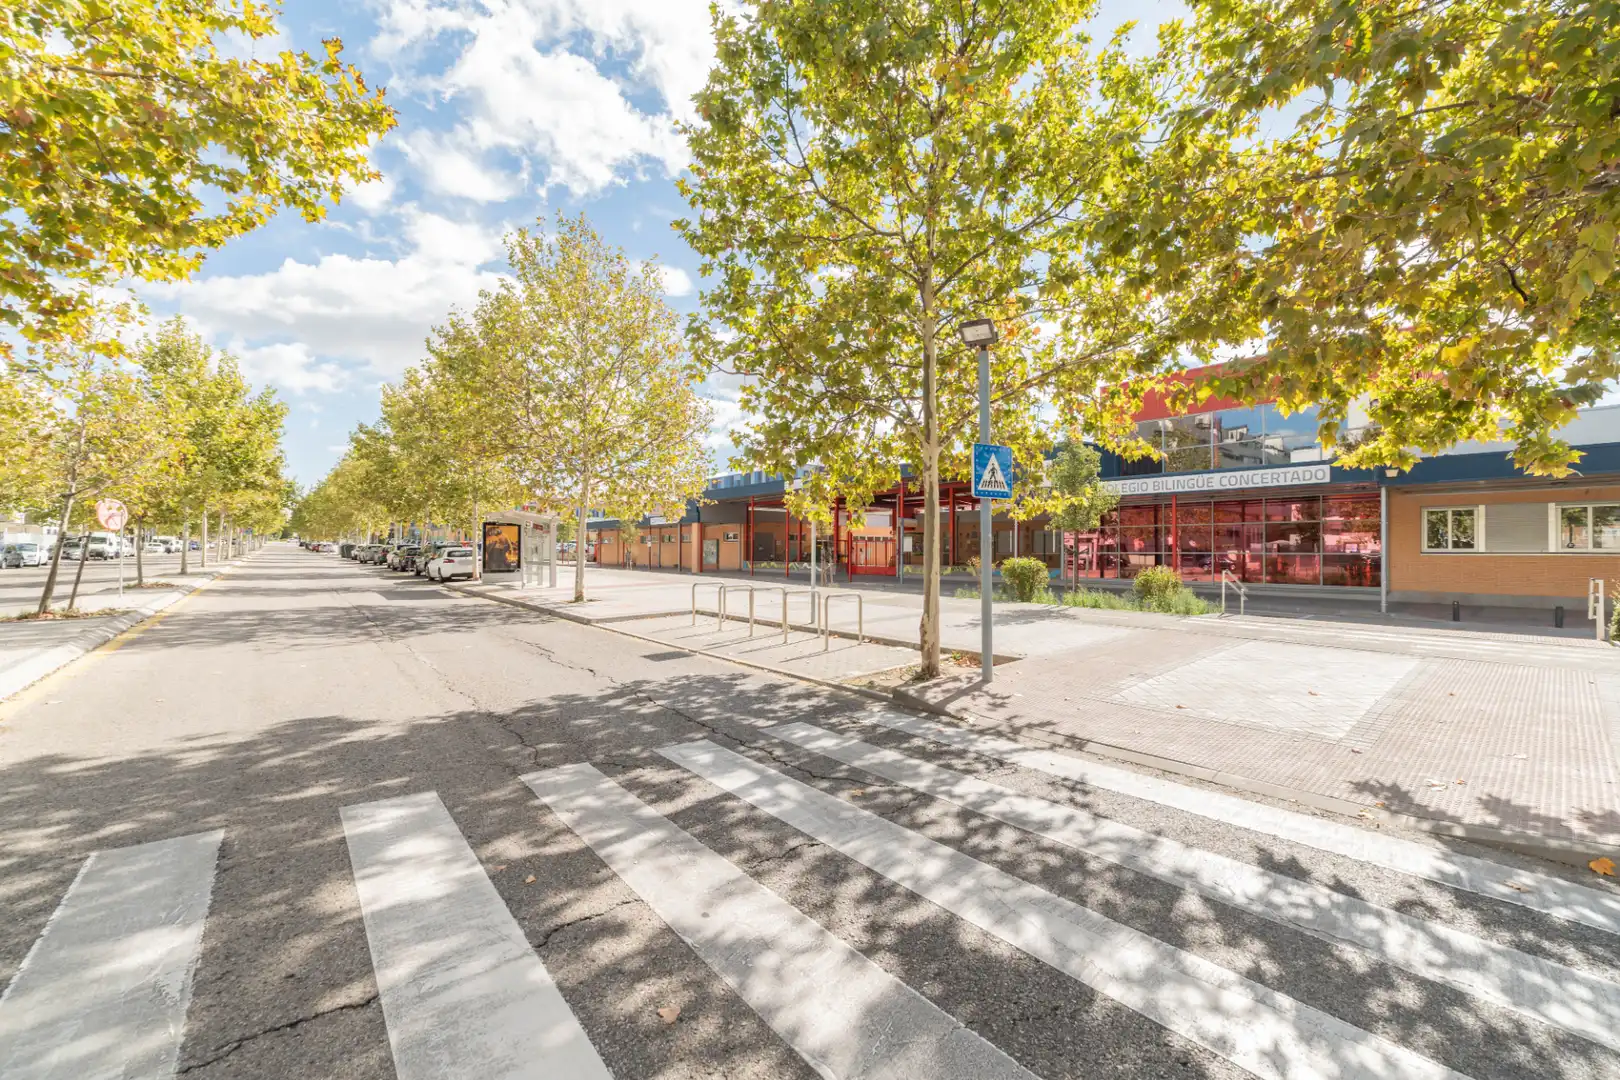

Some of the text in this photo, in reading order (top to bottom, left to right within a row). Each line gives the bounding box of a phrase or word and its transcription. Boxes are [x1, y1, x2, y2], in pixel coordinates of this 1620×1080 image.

[1101, 468, 1326, 494] OLEGIO BILINGÜE CONCERTADO
